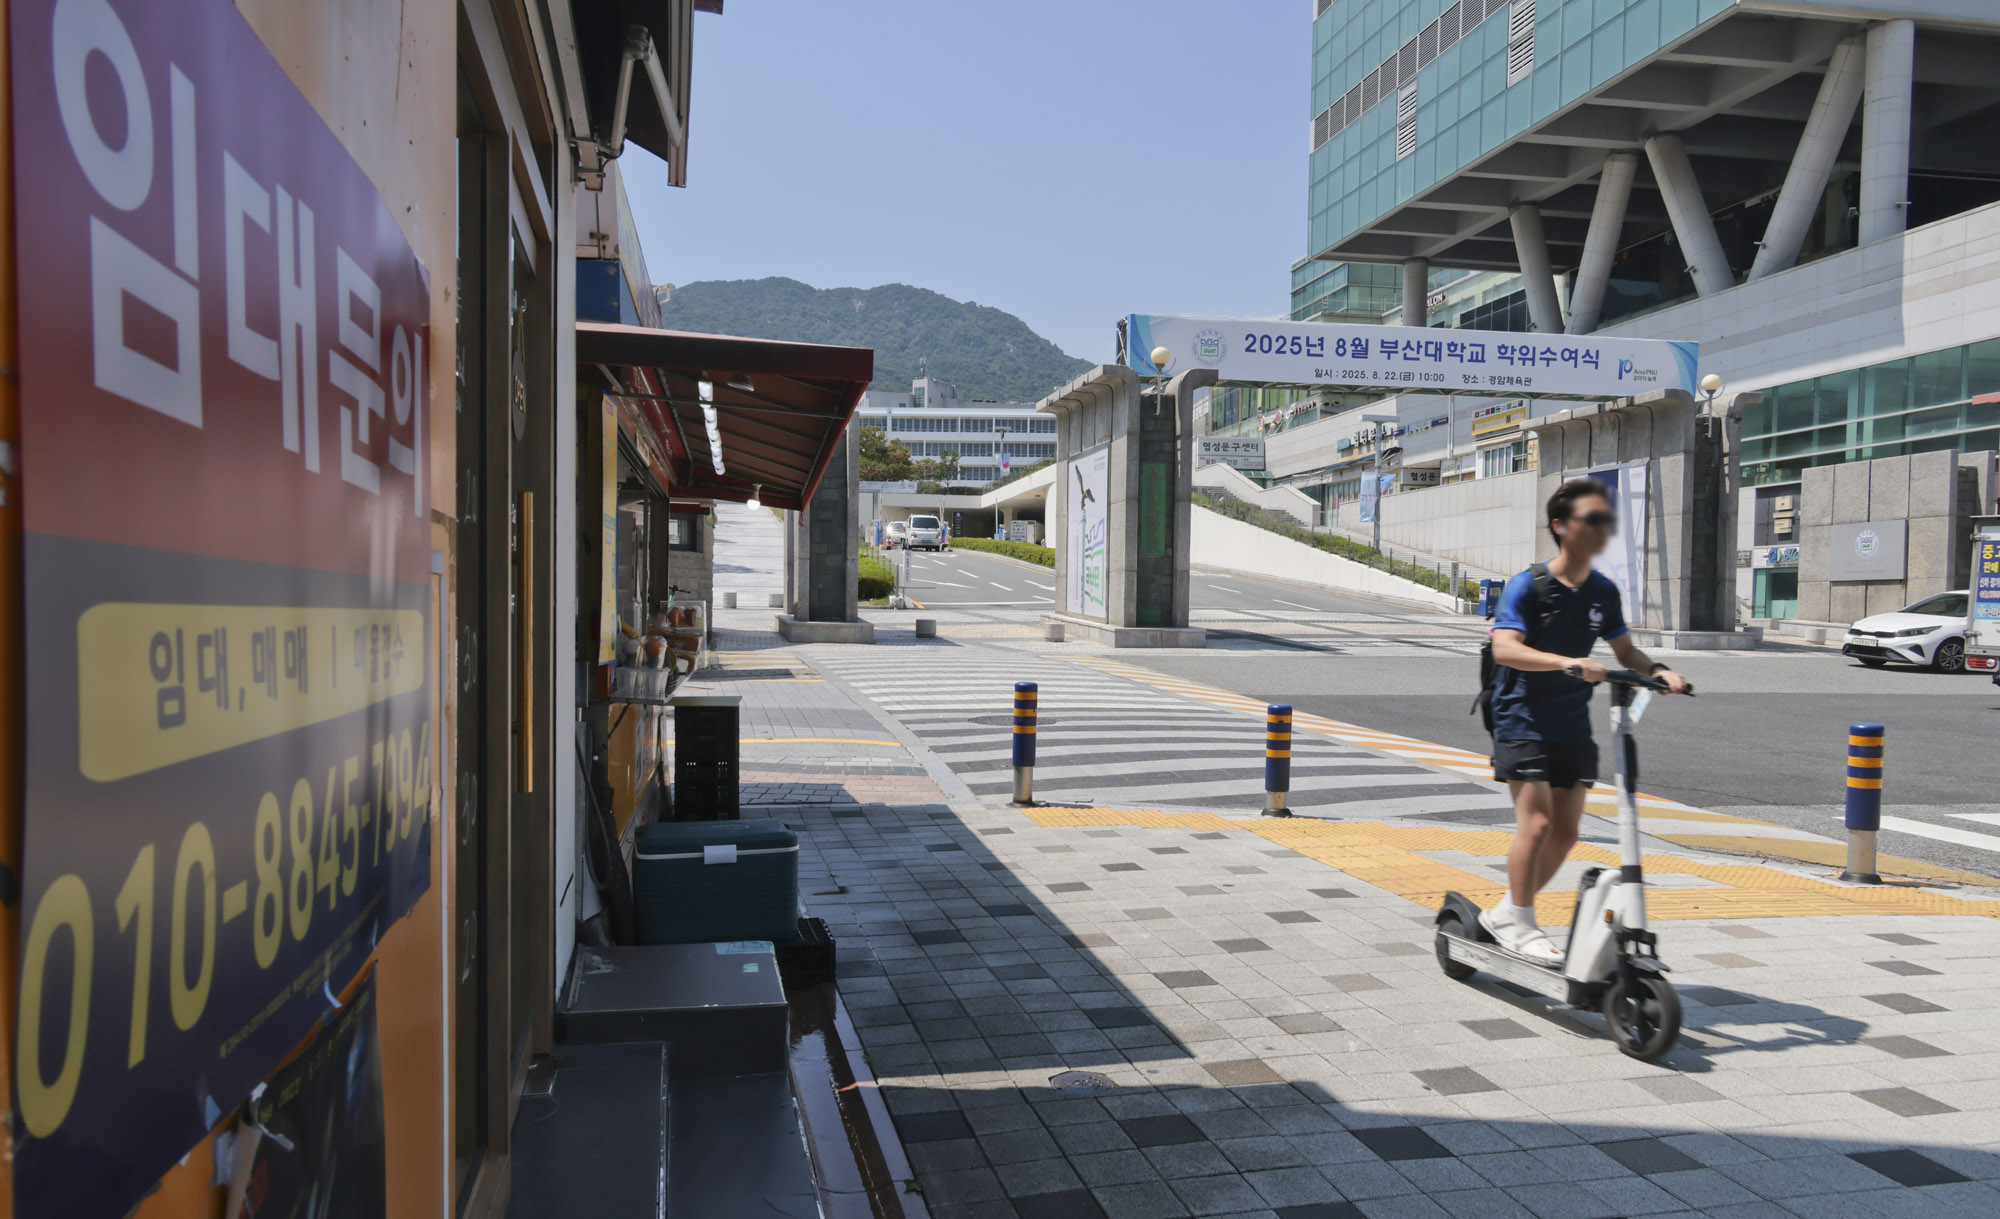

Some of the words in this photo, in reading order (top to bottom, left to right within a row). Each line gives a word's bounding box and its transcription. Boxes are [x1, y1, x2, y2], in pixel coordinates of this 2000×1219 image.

[51, 0, 424, 518] 임대문의
[1244, 334, 1325, 357] 2025년
[1335, 337, 1369, 359] 8월
[1379, 339, 1487, 364] 부산대학교
[1497, 343, 1600, 370] 학위수여식
[513, 375, 527, 415] OPEN
[1314, 368, 1333, 379] 일시
[1341, 370, 1368, 380] 2025.
[1372, 371, 1381, 380] 8.
[1384, 371, 1415, 382] 22.(금)
[1418, 372, 1445, 383] 10:00
[1461, 374, 1479, 384] 장소
[1488, 375, 1532, 387] 경암체육관
[1202, 441, 1259, 452] 협성문구센터
[1410, 471, 1440, 481] 협성문
[150, 624, 308, 729] 임대,매매
[17, 721, 431, 1140] 010-8845-7994
